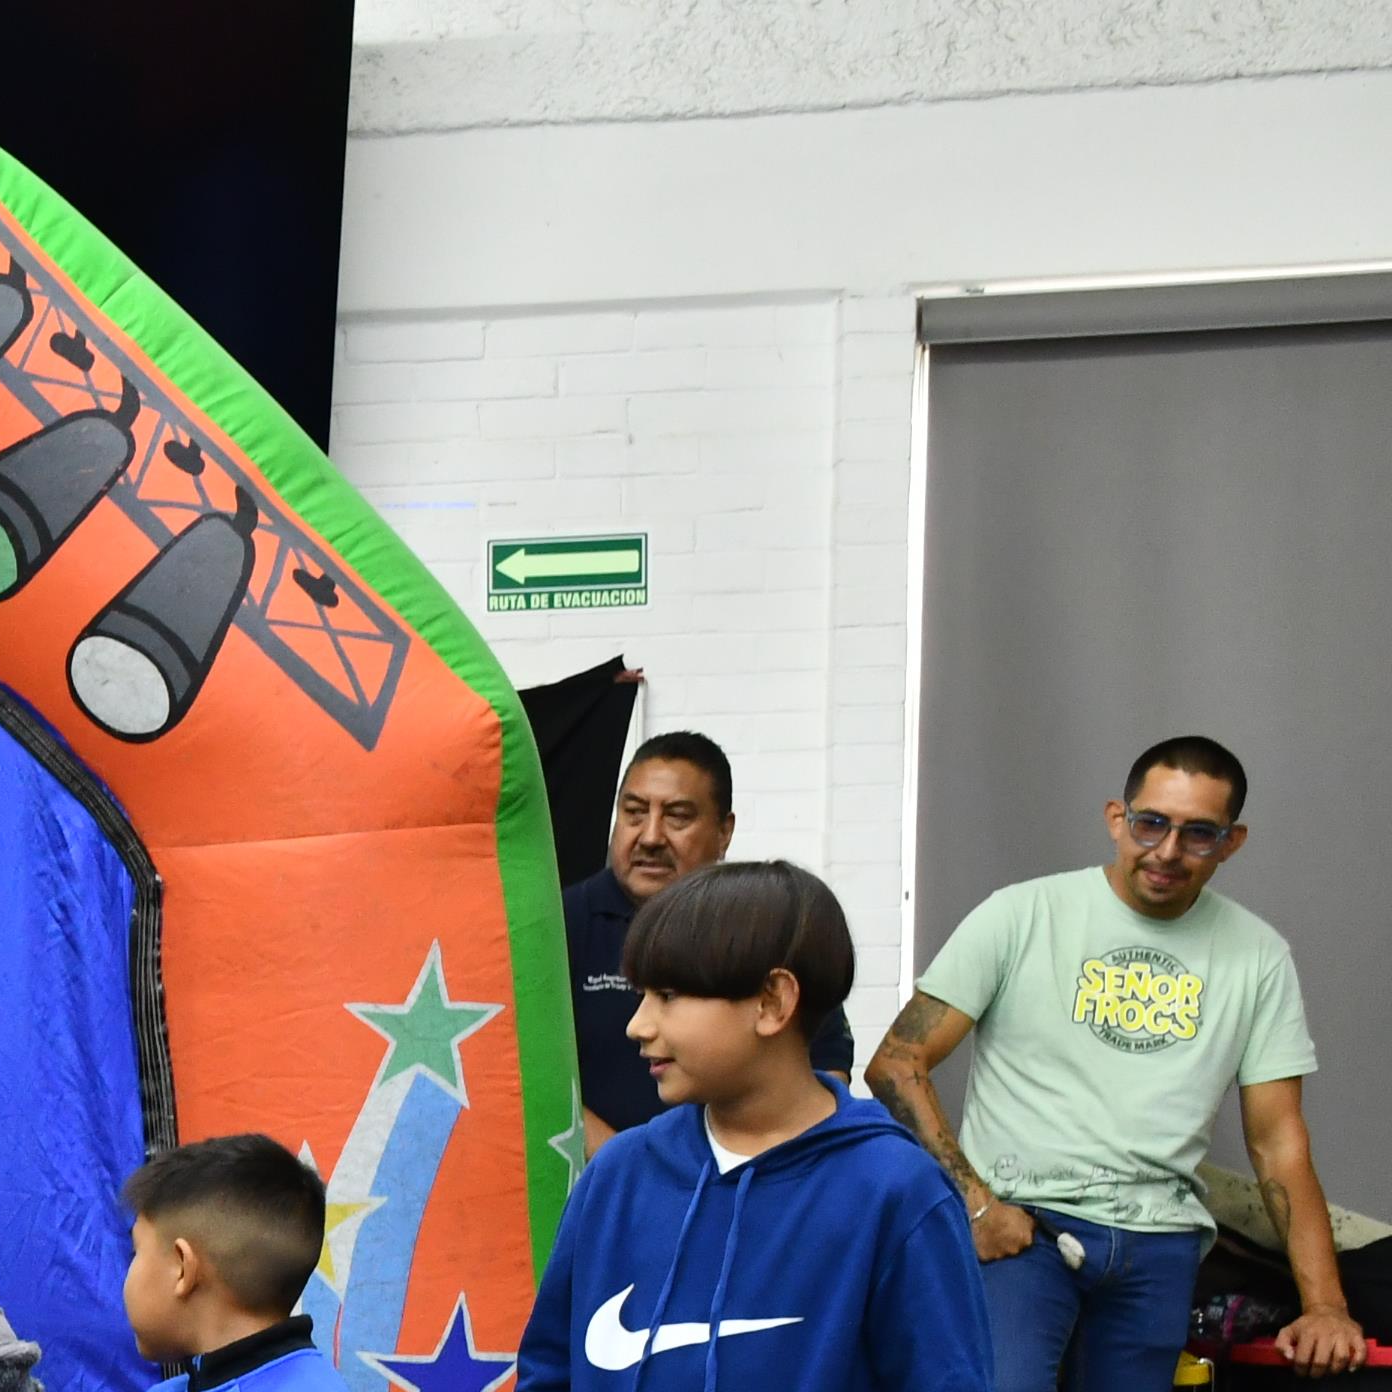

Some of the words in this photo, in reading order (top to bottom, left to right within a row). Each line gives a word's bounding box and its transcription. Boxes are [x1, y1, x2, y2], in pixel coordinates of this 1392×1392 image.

[488, 594, 527, 611] RUTA
[530, 592, 549, 609] DE
[553, 588, 646, 608] EVACUACION
[1111, 950, 1177, 973] AUTHENTIC
[1077, 959, 1204, 1008] SEÑOR
[1072, 989, 1201, 1041] FROGS
